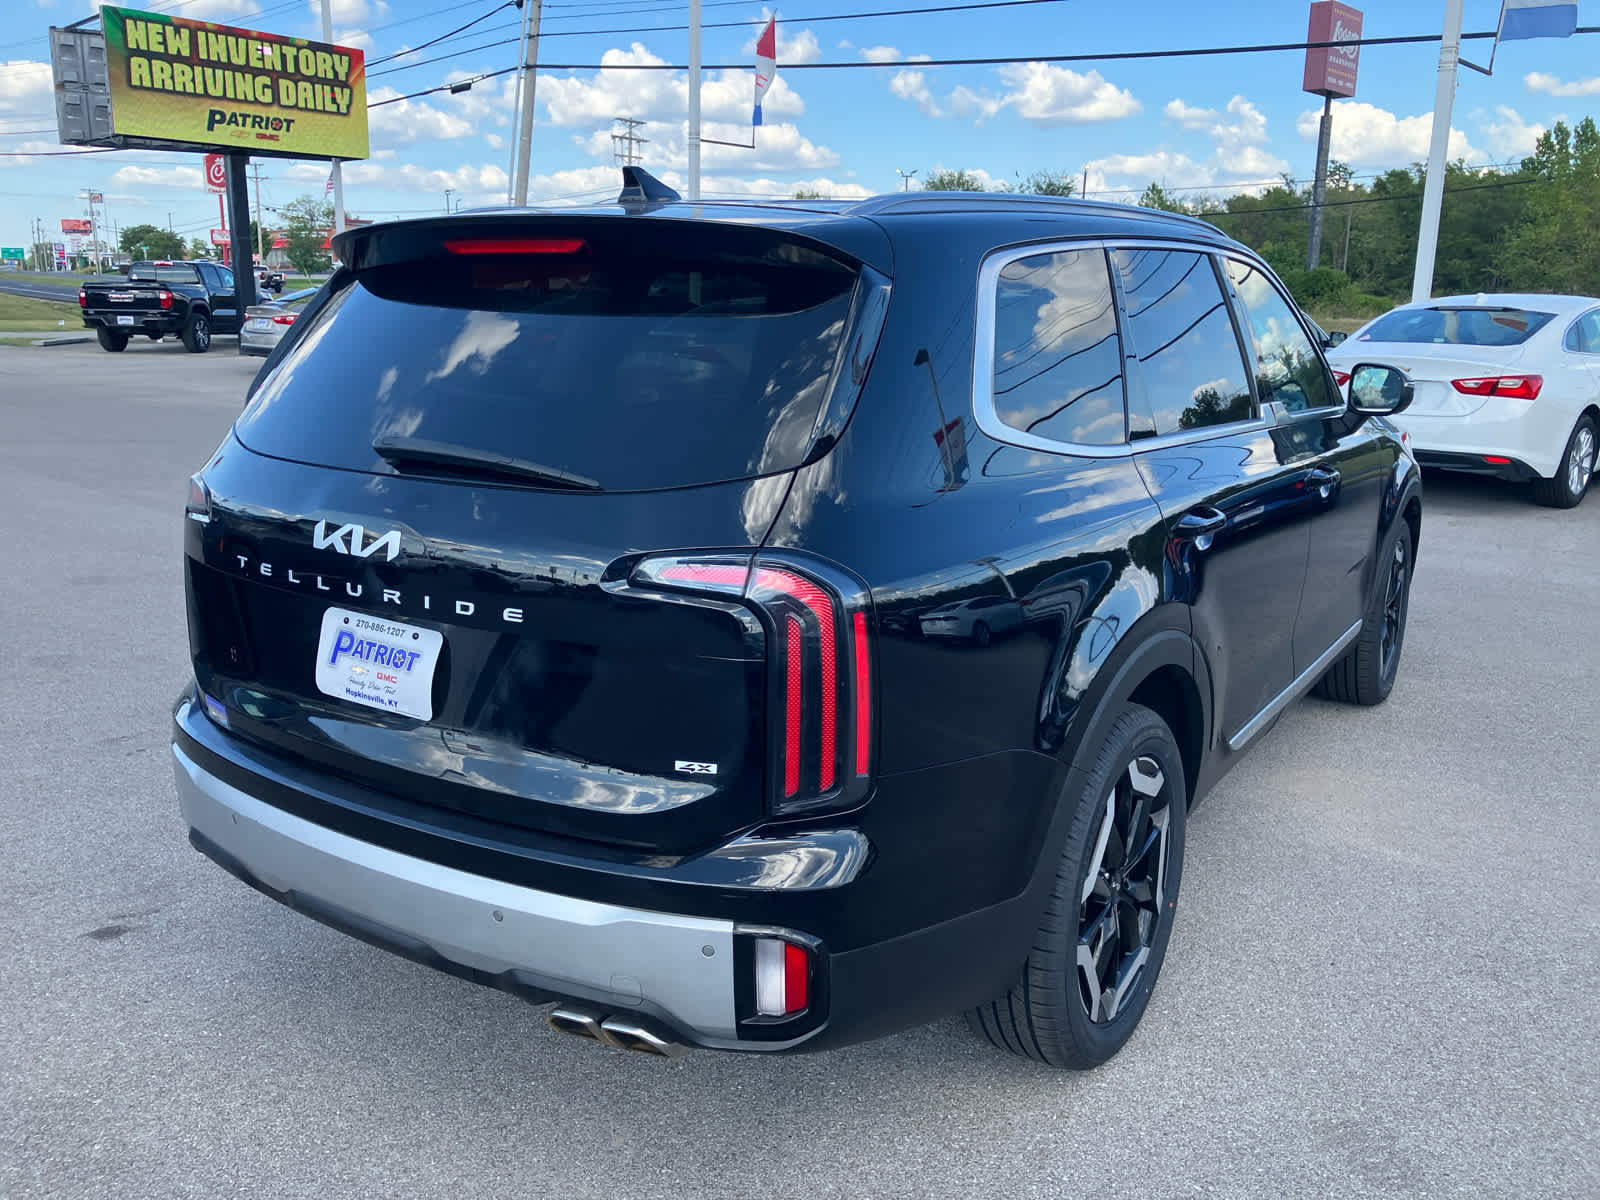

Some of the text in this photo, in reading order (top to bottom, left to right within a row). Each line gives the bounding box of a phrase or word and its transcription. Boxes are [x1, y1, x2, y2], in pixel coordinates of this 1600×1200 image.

[126, 18, 349, 81] NEW INVENTORY
[130, 56, 350, 114] ARRIVING DAILY
[207, 108, 295, 133] PATRIOT
[313, 520, 401, 561] KIA
[237, 555, 524, 622] TELLURIDE
[355, 619, 406, 637] 270-886-1207
[330, 630, 421, 672] PATRIOT
[345, 687, 399, 708] Hopkinsville, KY
[376, 672, 398, 684] GMC
